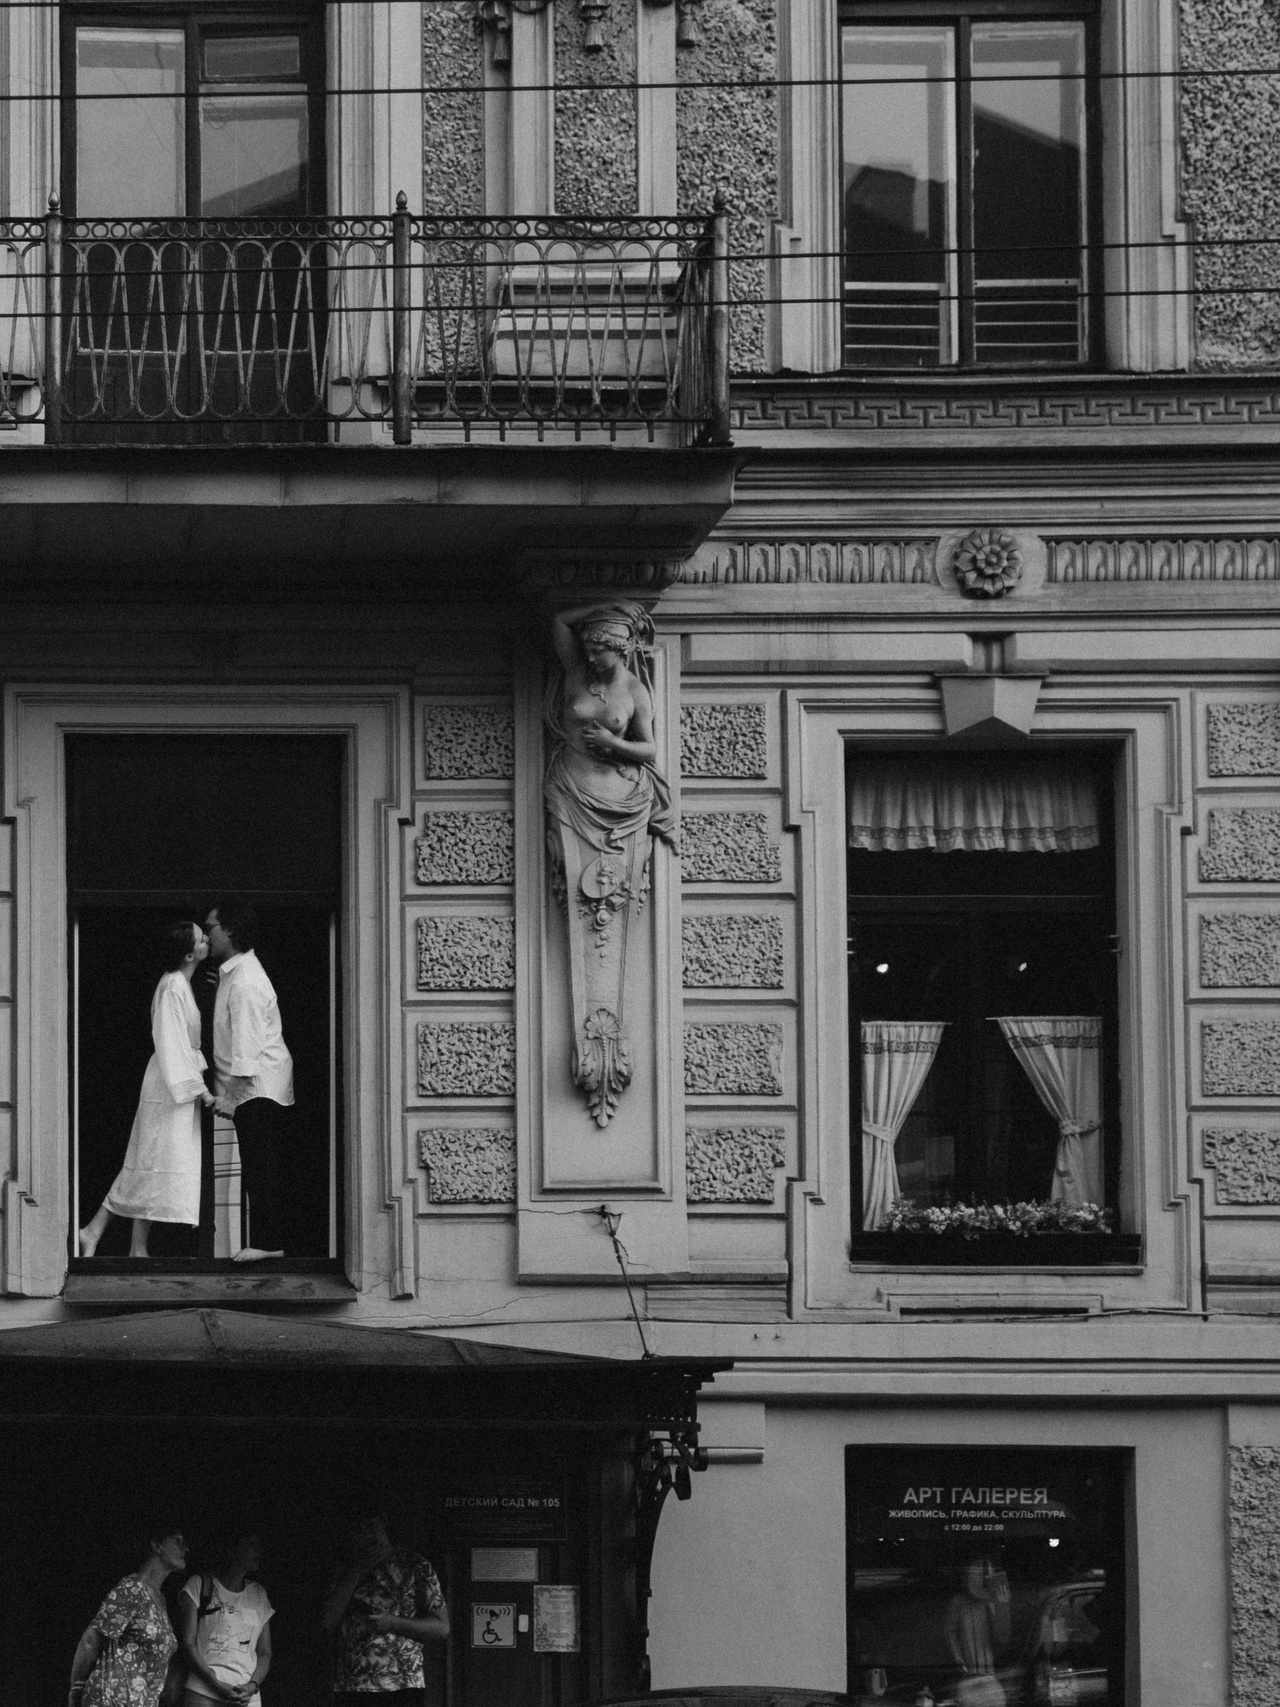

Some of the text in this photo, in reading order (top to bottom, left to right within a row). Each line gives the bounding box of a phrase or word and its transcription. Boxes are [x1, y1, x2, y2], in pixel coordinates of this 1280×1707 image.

[903, 1487, 1048, 1504] АРТ ГАЛЕРЕЯ
[444, 1496, 561, 1508] ДЕТСКИЙ САД № 105
[888, 1509, 1066, 1519] ЖИВОПИСЬ, ГРАФИКА, СКУЛЬПТУРА
